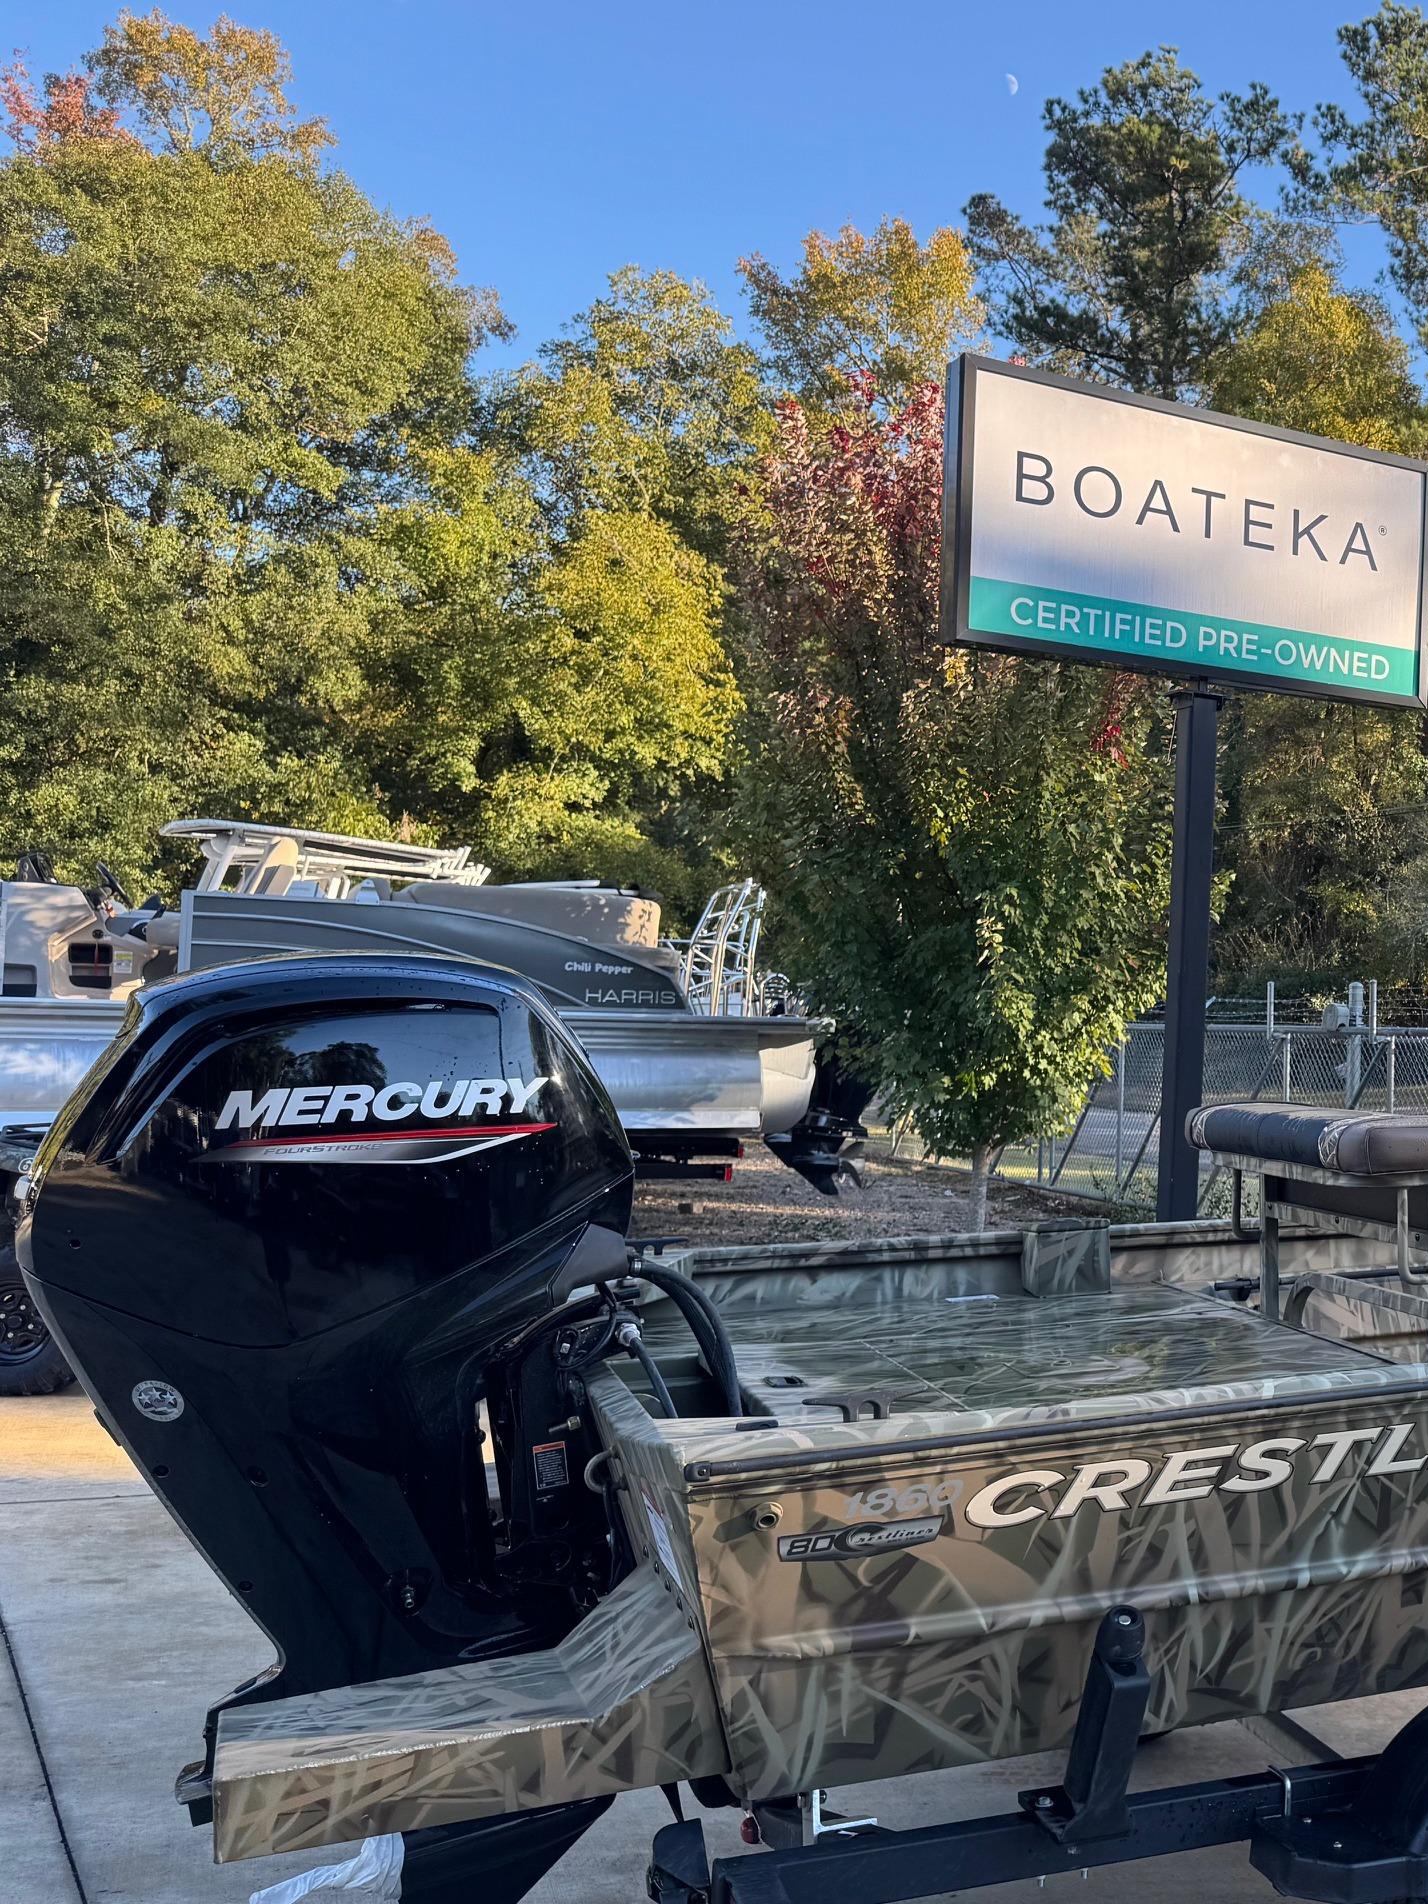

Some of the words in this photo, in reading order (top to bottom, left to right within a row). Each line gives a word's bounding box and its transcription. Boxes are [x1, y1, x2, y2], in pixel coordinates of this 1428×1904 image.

[1015, 450, 1378, 571] BOATEKA
[1010, 597, 1187, 649] CERTIFIED
[1198, 626, 1390, 681] PRE-OWNED
[564, 961, 592, 972] Chili
[595, 963, 634, 975] Pepper
[585, 988, 676, 1005] HARRIS
[215, 1077, 549, 1130] MERCURY
[846, 1480, 964, 1519] 1860
[787, 1535, 835, 1555] 80
